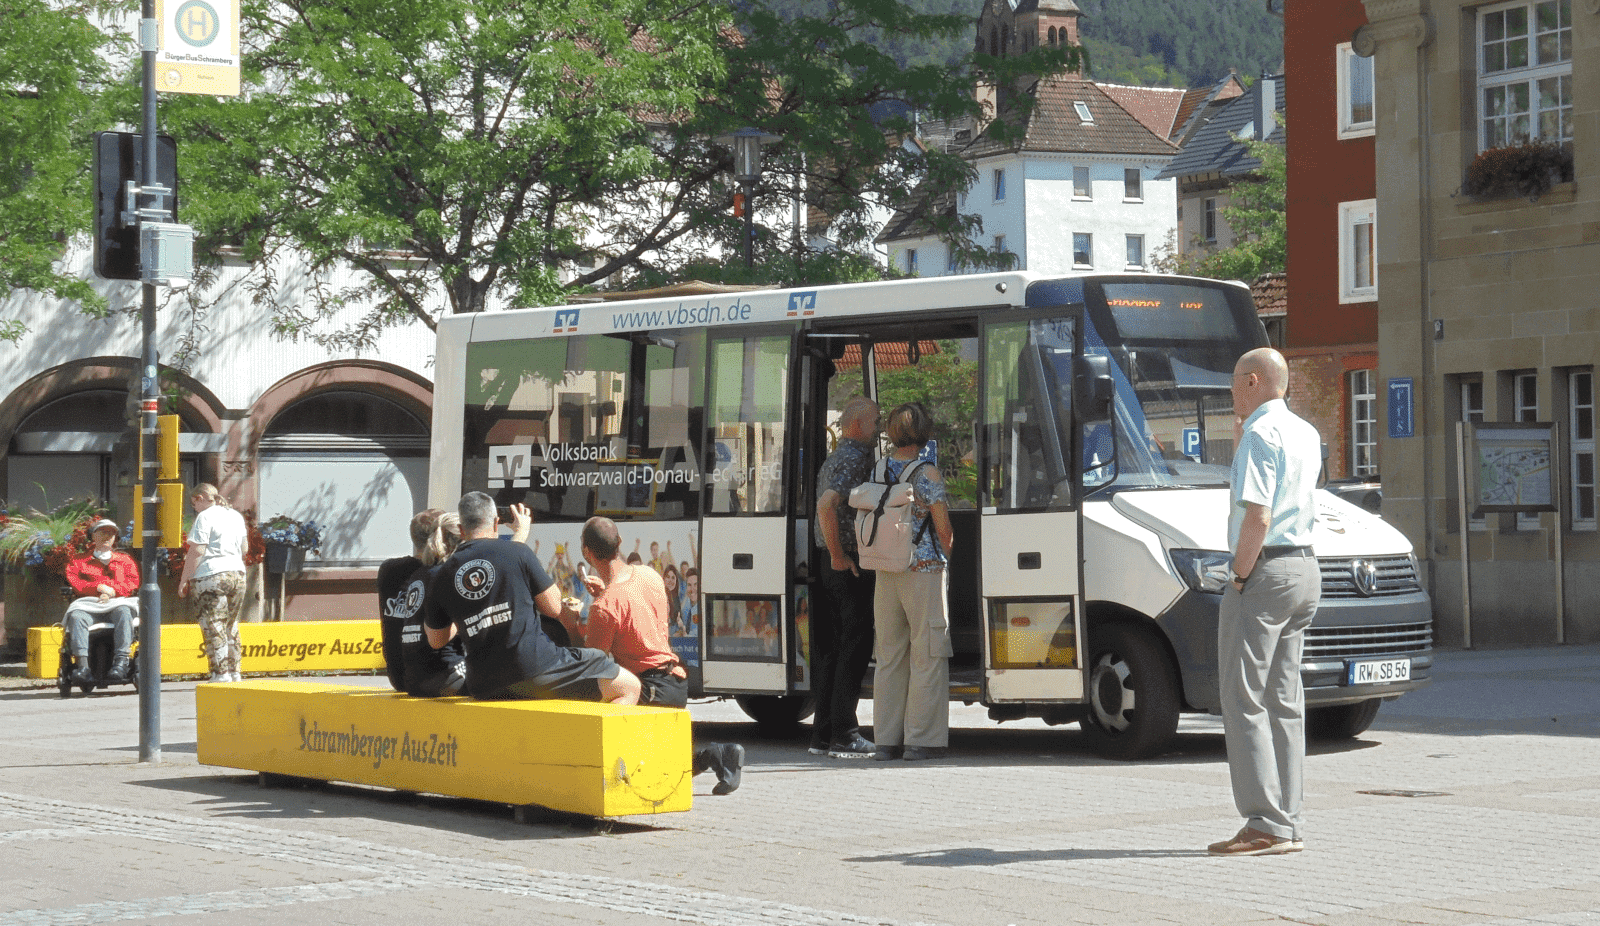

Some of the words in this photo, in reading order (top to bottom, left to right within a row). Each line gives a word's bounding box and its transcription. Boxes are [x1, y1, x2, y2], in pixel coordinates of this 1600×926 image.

[188, 10, 207, 36] H
[165, 52, 233, 65] BürgerBusSchramberg
[613, 298, 752, 329] www.vbsdn.de
[540, 441, 617, 462] Volksbank
[1188, 431, 1200, 453] P
[493, 610, 513, 625] BEST
[197, 639, 326, 661] Samberger
[329, 638, 383, 656] AusZe
[1359, 664, 1374, 681] RW
[1380, 662, 1393, 679] SB
[1395, 661, 1407, 678] 56
[299, 718, 398, 770] Schramberger
[401, 731, 458, 767] AusZeit
